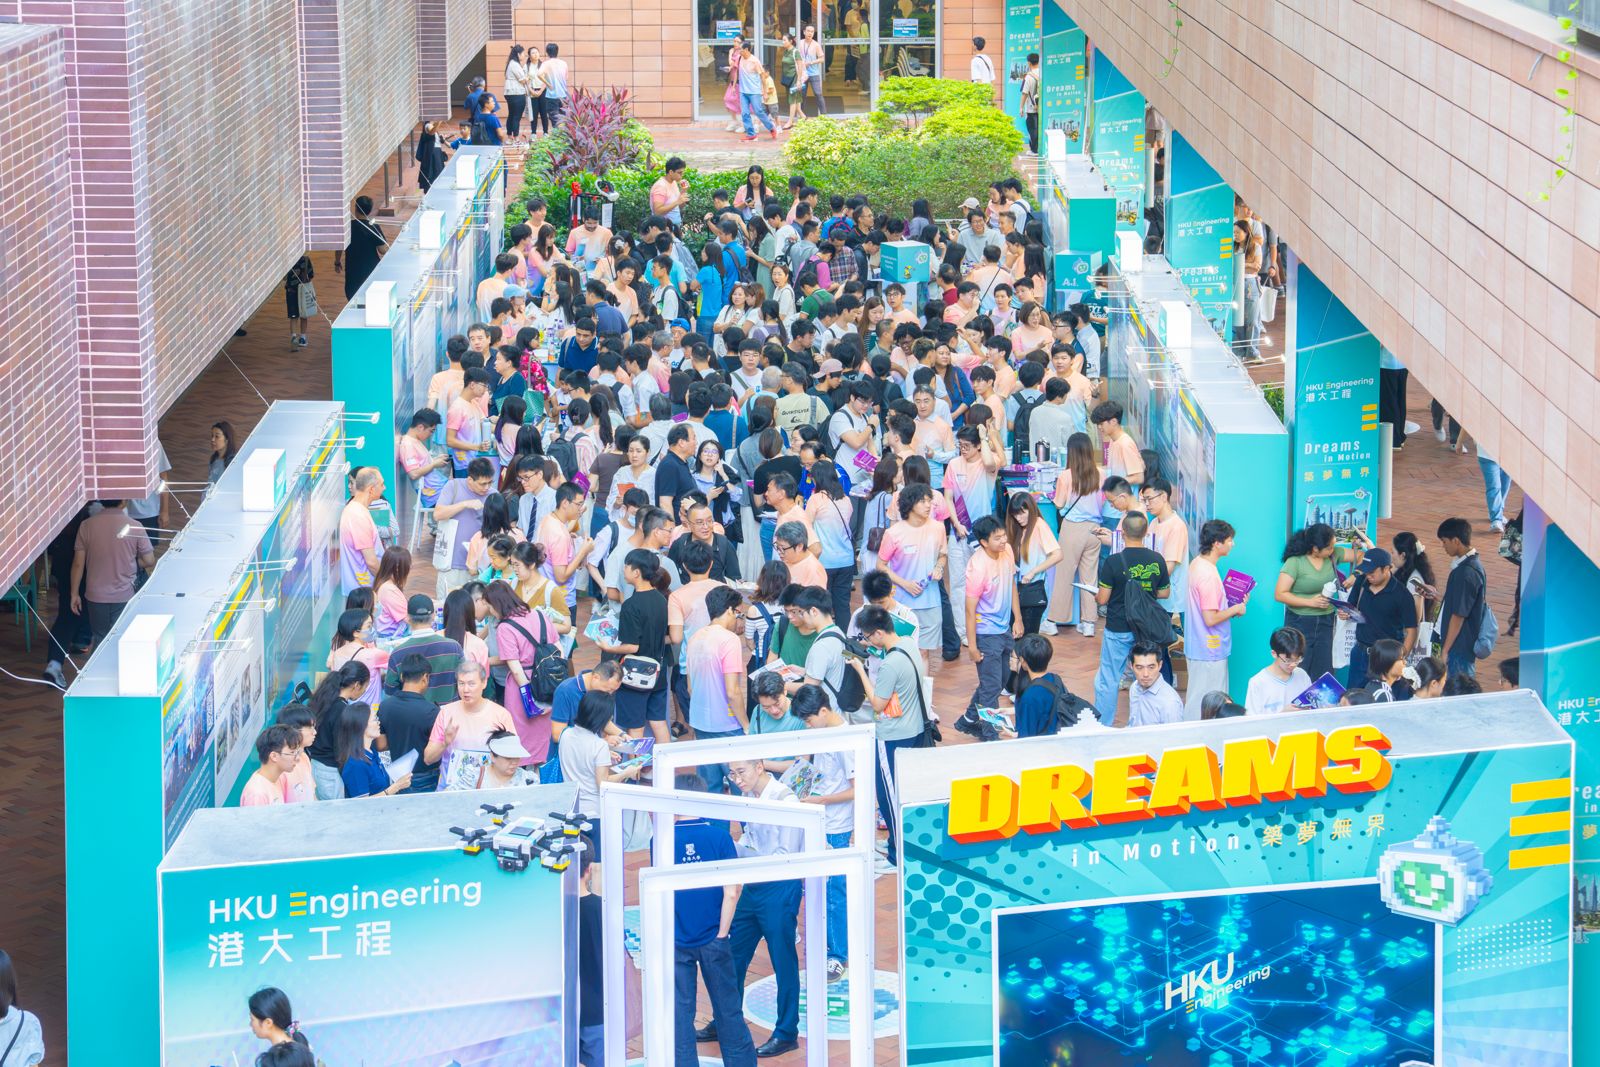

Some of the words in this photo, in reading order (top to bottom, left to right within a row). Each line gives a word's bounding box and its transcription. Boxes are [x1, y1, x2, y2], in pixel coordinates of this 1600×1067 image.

[1193, 217, 1230, 228] Engineering
[1202, 274, 1228, 283] Motion
[1305, 383, 1324, 392] HKU
[1325, 377, 1374, 391] Engineering
[1305, 388, 1352, 403] 港大工程
[1304, 440, 1360, 455] Dreams
[1324, 453, 1334, 463] in
[1338, 452, 1371, 462] Motion
[1558, 698, 1585, 710] HKU
[947, 723, 1393, 844] DREAMS
[1585, 802, 1598, 813] in
[1261, 813, 1385, 848] 築夢無界
[1071, 848, 1101, 868] in
[1122, 834, 1241, 862] Motion
[208, 894, 278, 924] HKU
[289, 878, 483, 919] Engineering
[207, 920, 392, 968] 港大工程
[1164, 951, 1235, 1011] HKU
[1185, 965, 1271, 1014] Engineering
